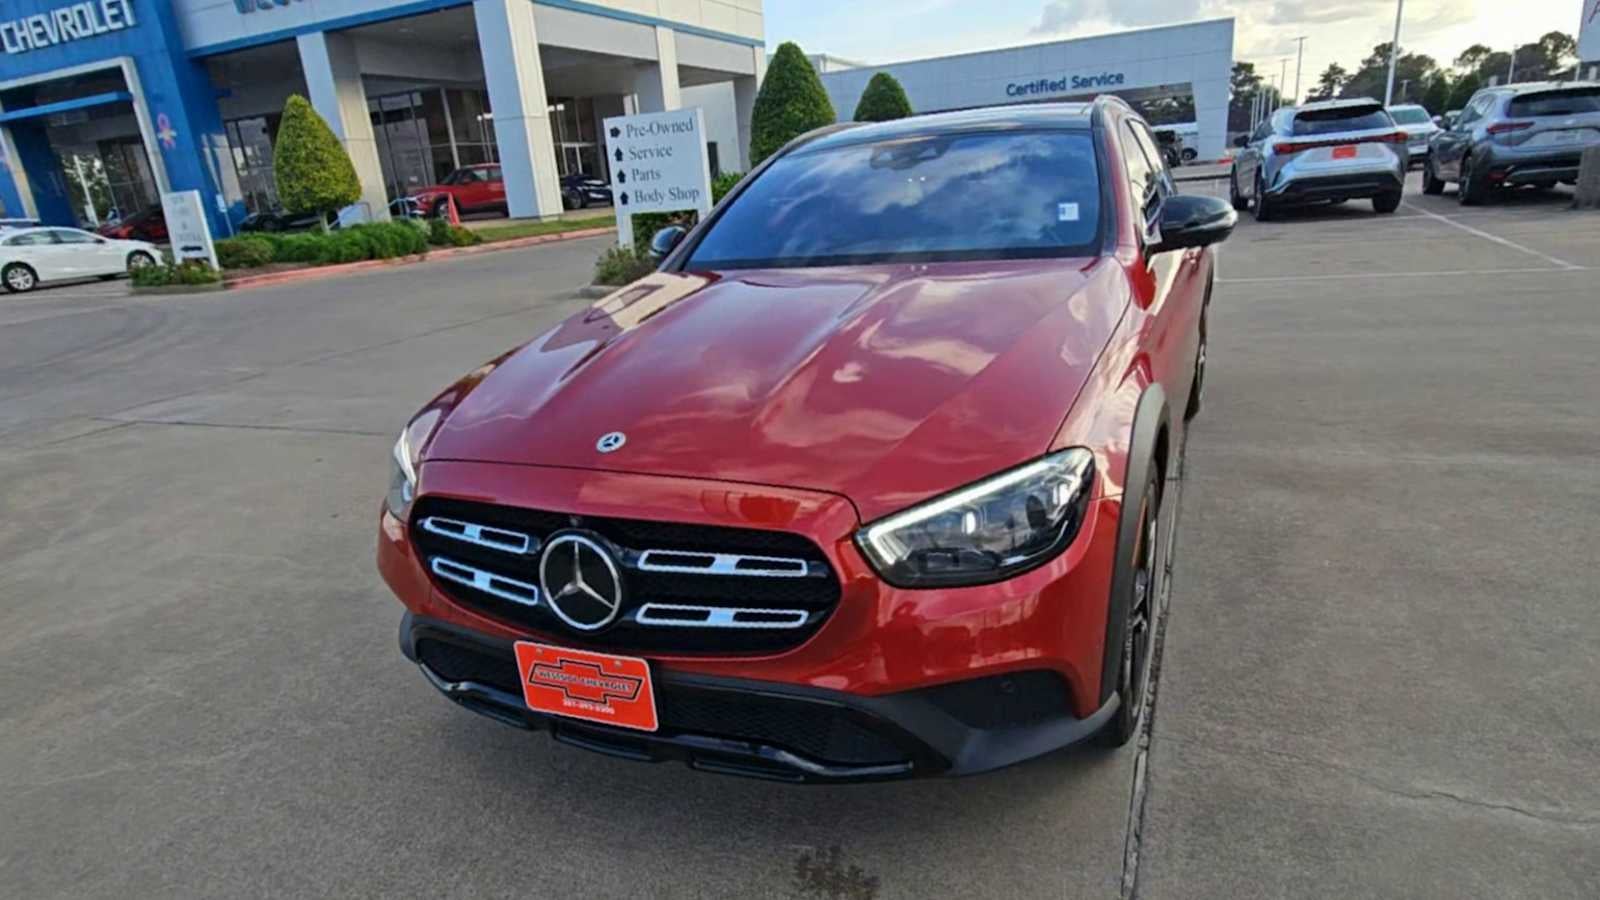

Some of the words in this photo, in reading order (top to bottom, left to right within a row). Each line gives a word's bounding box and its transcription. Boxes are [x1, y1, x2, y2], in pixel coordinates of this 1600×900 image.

[0, 0, 136, 54] CHEVROLET
[1006, 77, 1067, 97] Certified
[1072, 71, 1125, 89] Service
[626, 118, 694, 138] Pre-Owned
[628, 145, 673, 160] Service
[632, 168, 661, 182] Parts
[634, 188, 664, 205] Body
[668, 186, 700, 203] Shop
